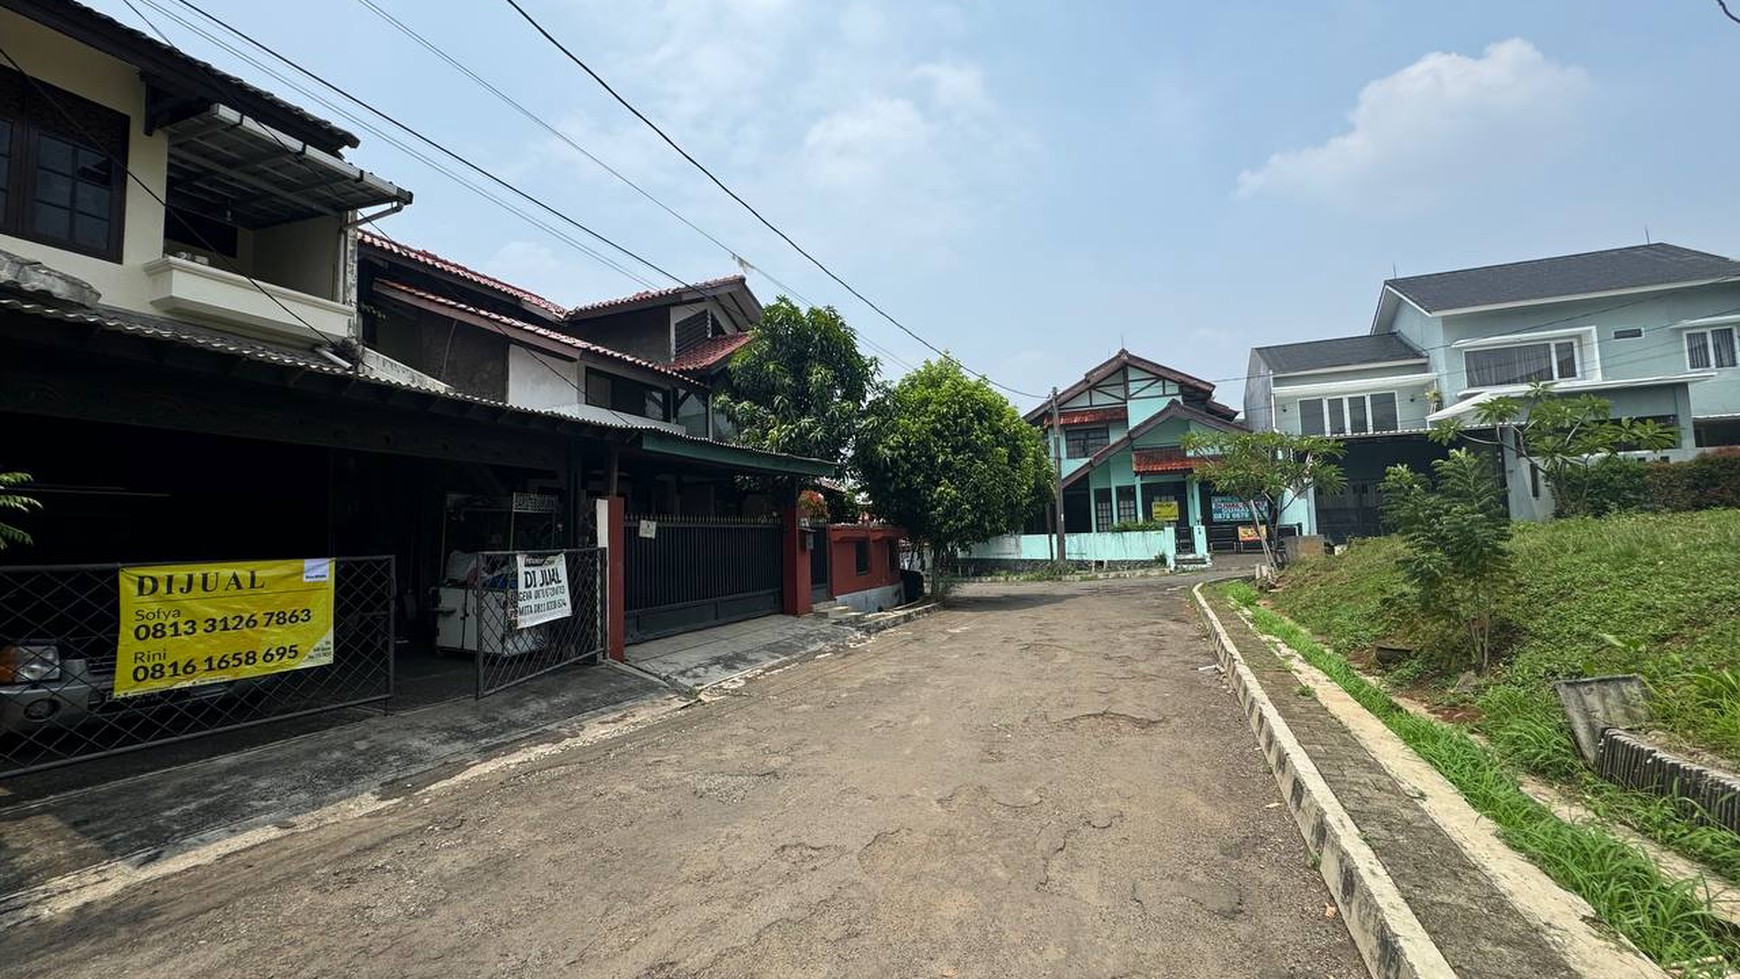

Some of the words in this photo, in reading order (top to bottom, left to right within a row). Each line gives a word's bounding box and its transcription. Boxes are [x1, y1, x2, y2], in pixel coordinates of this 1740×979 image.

[137, 570, 266, 597] DIJUAL
[524, 570, 537, 588] DI
[540, 567, 562, 587] JUAL
[134, 607, 181, 623] Sofya
[134, 620, 197, 641] 0813
[203, 612, 258, 633] 3126
[263, 608, 312, 627] 7863
[132, 659, 197, 683] 0816
[204, 651, 257, 672] 1658
[262, 645, 299, 663] 695
[134, 649, 167, 664] Rini
